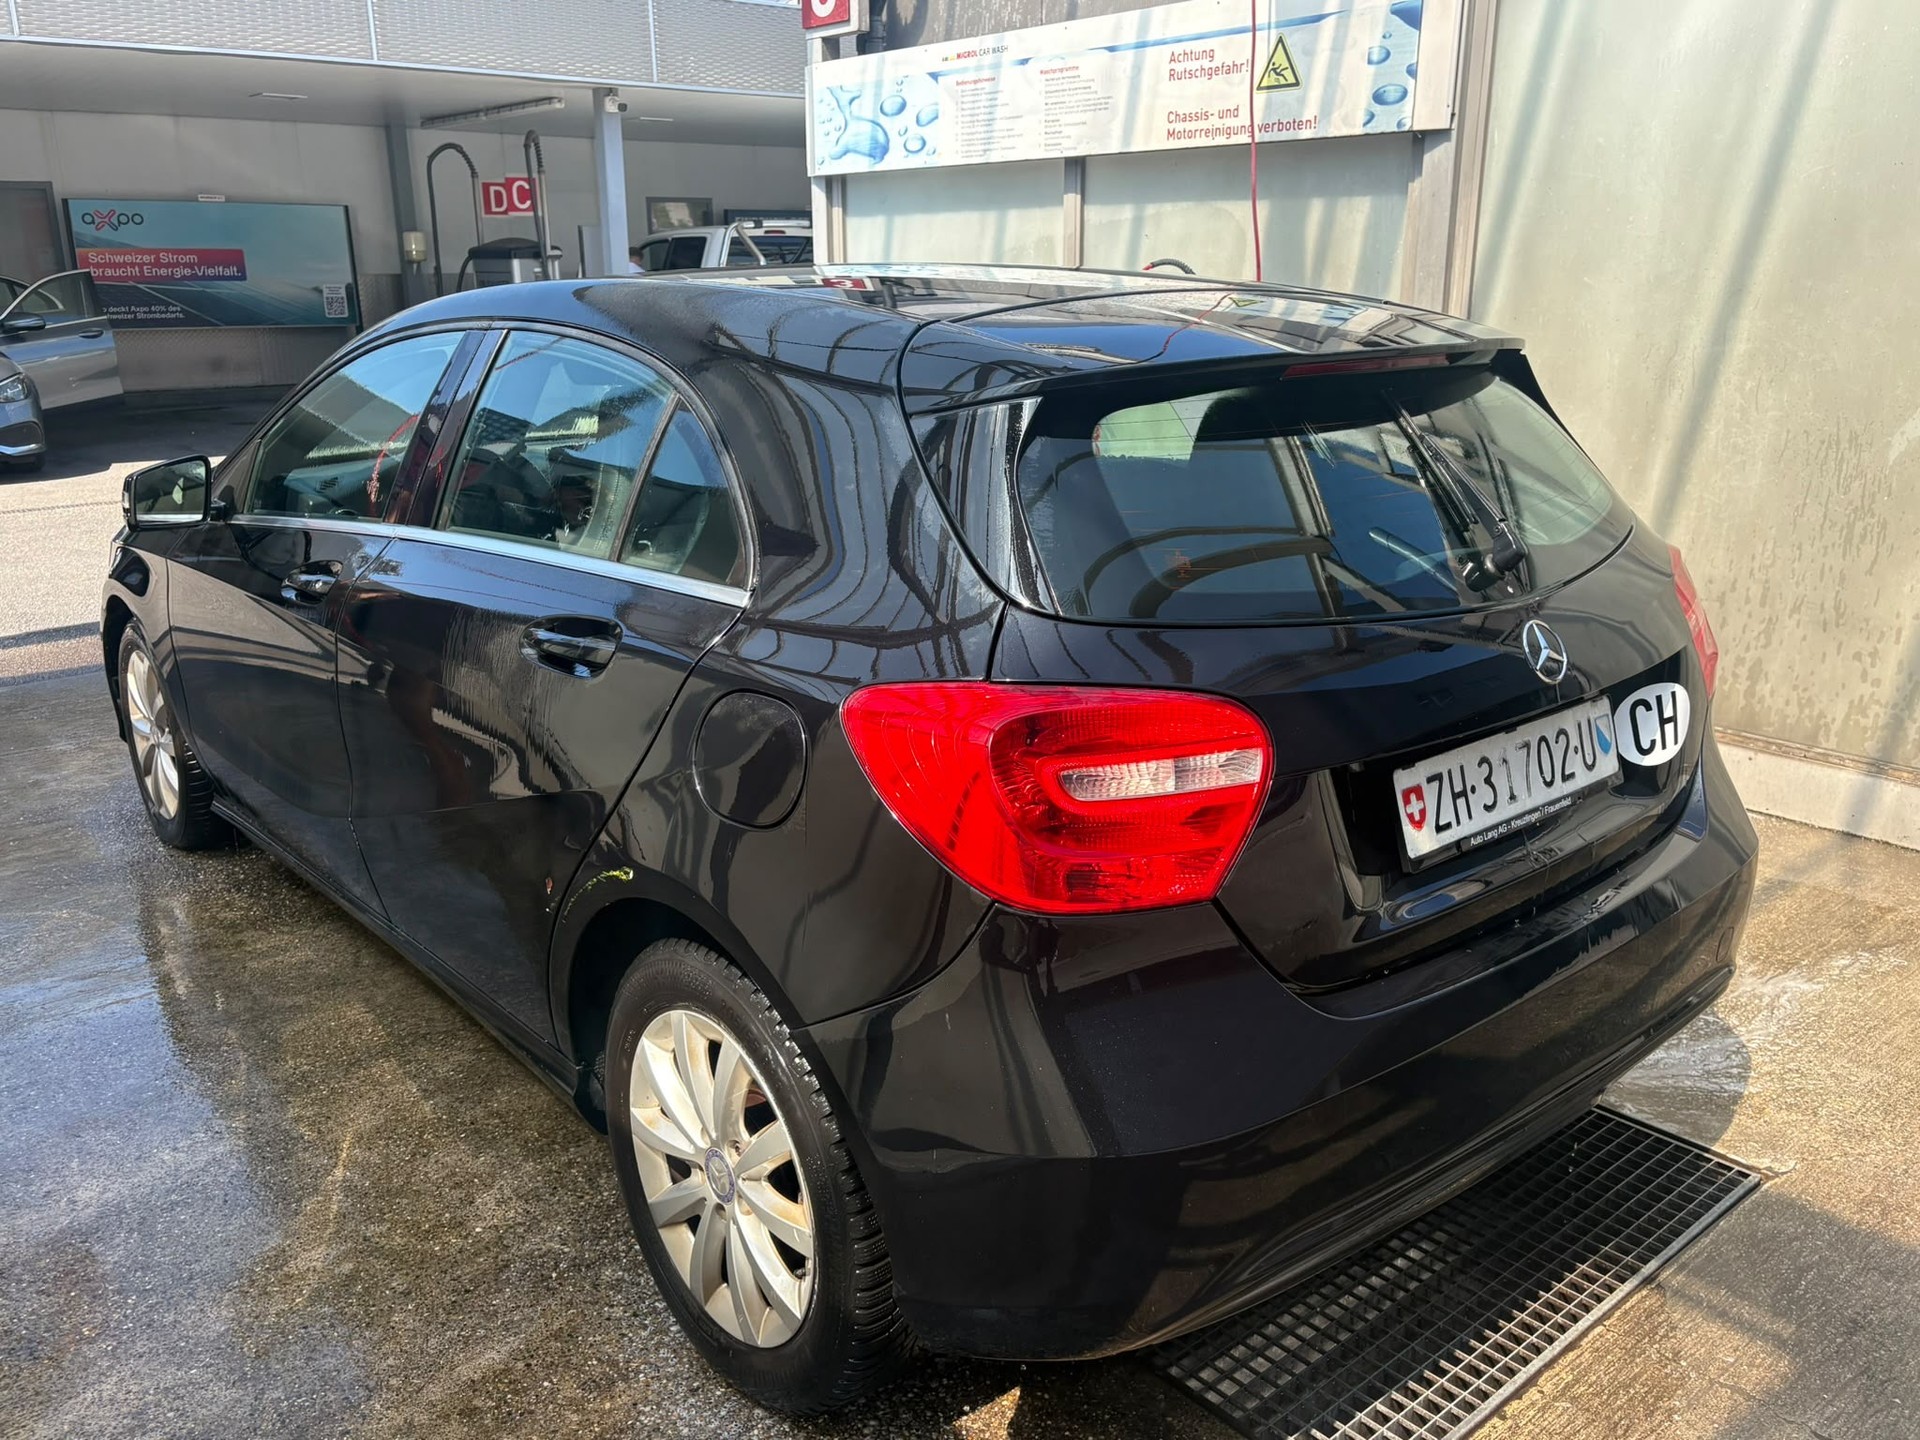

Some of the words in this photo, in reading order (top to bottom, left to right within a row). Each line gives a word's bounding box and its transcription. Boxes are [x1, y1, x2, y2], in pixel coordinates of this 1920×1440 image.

[979, 48, 990, 57] CAR
[992, 45, 1008, 54] WASH
[1168, 49, 1215, 64] Achtung
[1168, 59, 1250, 82] Rutschgefahr!
[1167, 108, 1215, 124] Chassis-
[1217, 105, 1240, 119] und
[1167, 123, 1254, 141] Motorreinigung
[1257, 115, 1318, 134] verboten!
[81, 209, 144, 232] axpo
[88, 252, 156, 264] Schweizer
[159, 252, 198, 264] Strom
[91, 266, 140, 277] braucht
[143, 266, 242, 279] Energie-Vielfalt.
[130, 305, 149, 313] Axpo
[136, 312, 186, 320] Strombedarfs.
[1629, 690, 1679, 757] CH
[1470, 834, 1484, 847] Auto
[1484, 830, 1499, 842] Lang
[1498, 823, 1508, 834] AG
[1511, 807, 1541, 828] Kreuzlingen
[1544, 797, 1573, 816] Frauenfeld
